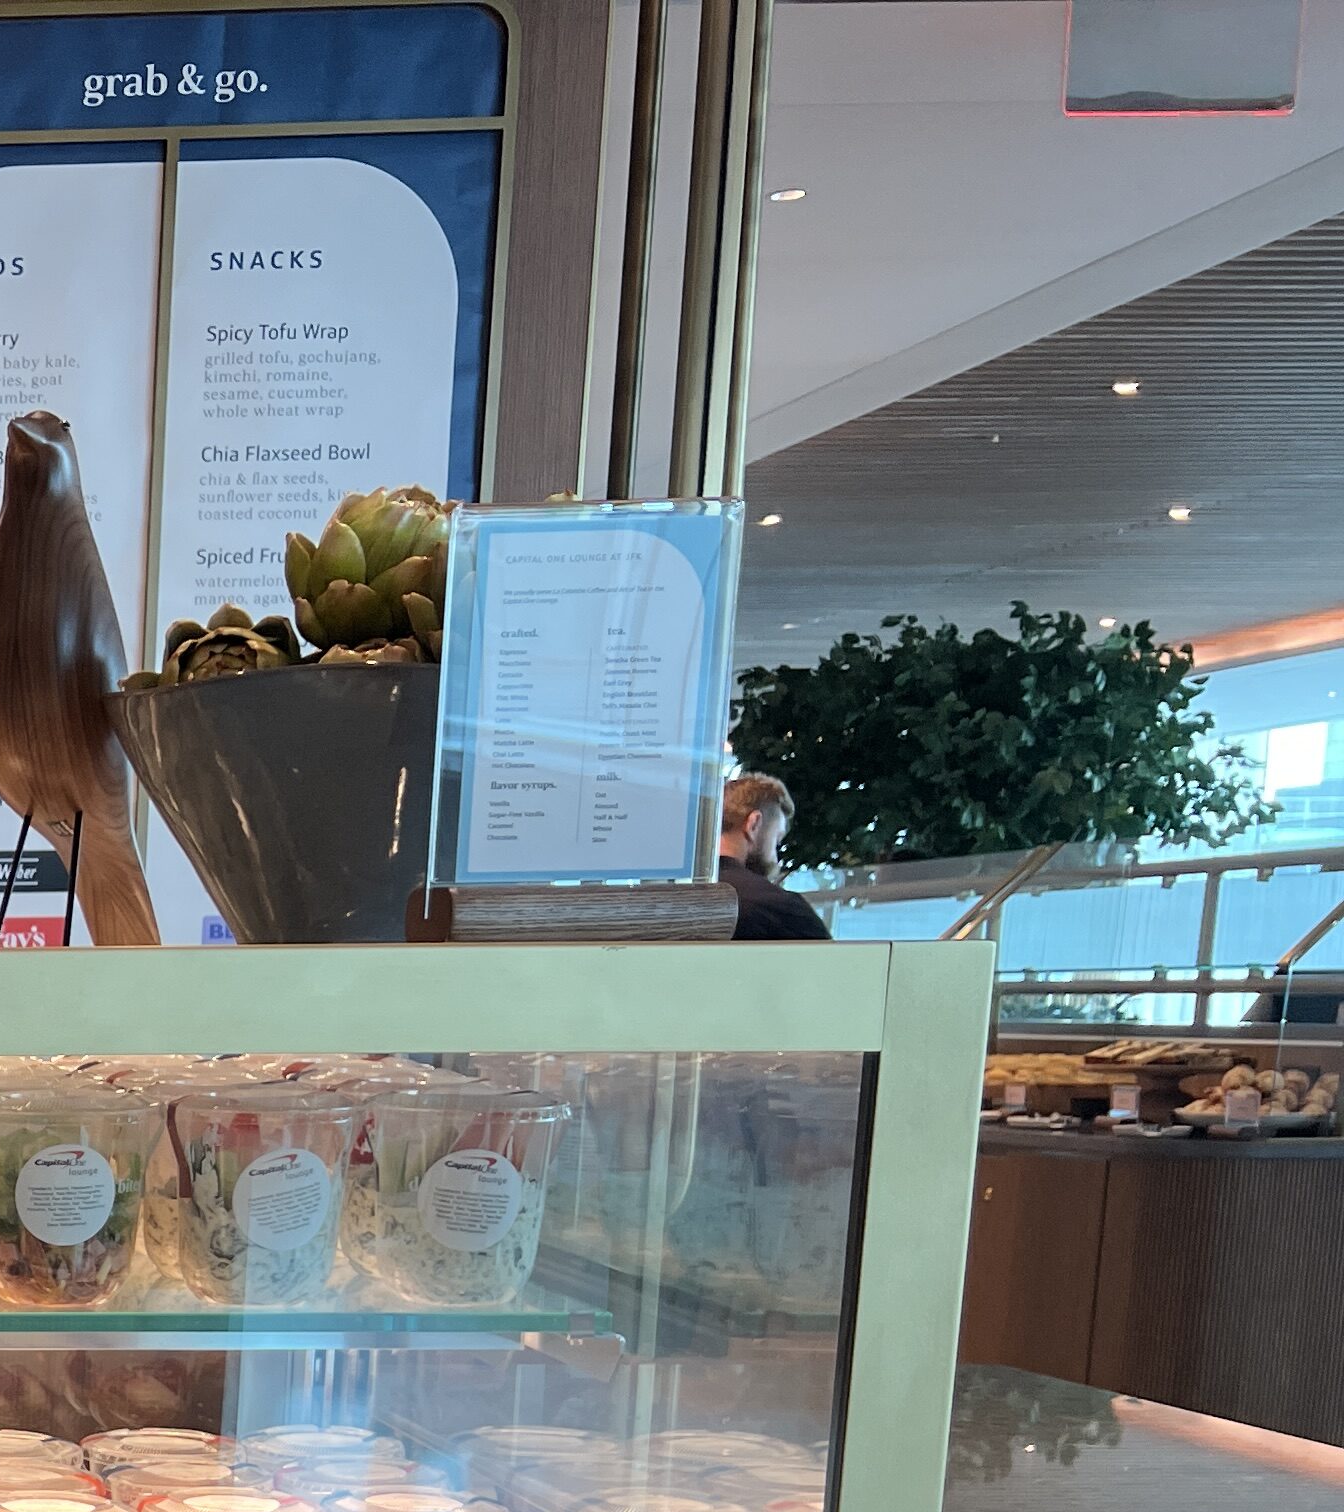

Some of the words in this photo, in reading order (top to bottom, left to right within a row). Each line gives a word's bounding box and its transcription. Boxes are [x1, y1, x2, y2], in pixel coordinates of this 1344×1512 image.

[83, 63, 168, 107] grab
[177, 63, 206, 95] &
[214, 66, 268, 104] go.
[210, 250, 322, 271] SNACKS
[206, 325, 253, 346] Spicy
[259, 323, 296, 341] Tofu
[303, 324, 348, 343] Wrap
[3, 356, 39, 371] baby
[45, 355, 80, 369] kale,
[205, 352, 253, 368] grilled
[259, 350, 293, 366] tofu,
[298, 350, 381, 366] gochujang,
[31, 375, 62, 388] goat
[204, 369, 261, 384] kimchi,
[266, 369, 333, 382] romaine,
[203, 389, 263, 401] sesame,
[268, 386, 347, 400] cucumber,
[203, 406, 248, 418] whole
[254, 404, 299, 417] wheat
[306, 406, 344, 418] wrap
[202, 446, 239, 462] Chia
[246, 444, 322, 462] Flaxseed
[329, 443, 370, 460] Bowl
[200, 473, 231, 486] chia
[236, 473, 247, 485] &
[252, 472, 277, 484] flax
[283, 471, 328, 485] seeds,
[199, 490, 272, 504] sunflower
[278, 489, 323, 504] seeds,
[198, 507, 253, 520] toasted
[258, 508, 318, 519] coconut
[197, 548, 254, 568] Spiced
[505, 555, 542, 564] CAPITAL
[547, 555, 565, 563] ONE
[570, 553, 607, 562] LOUNGE
[610, 553, 621, 561] AT
[626, 553, 642, 561] JFK
[501, 628, 539, 638] crafted.
[490, 781, 518, 790] flavor
[521, 781, 557, 791] syrups.
